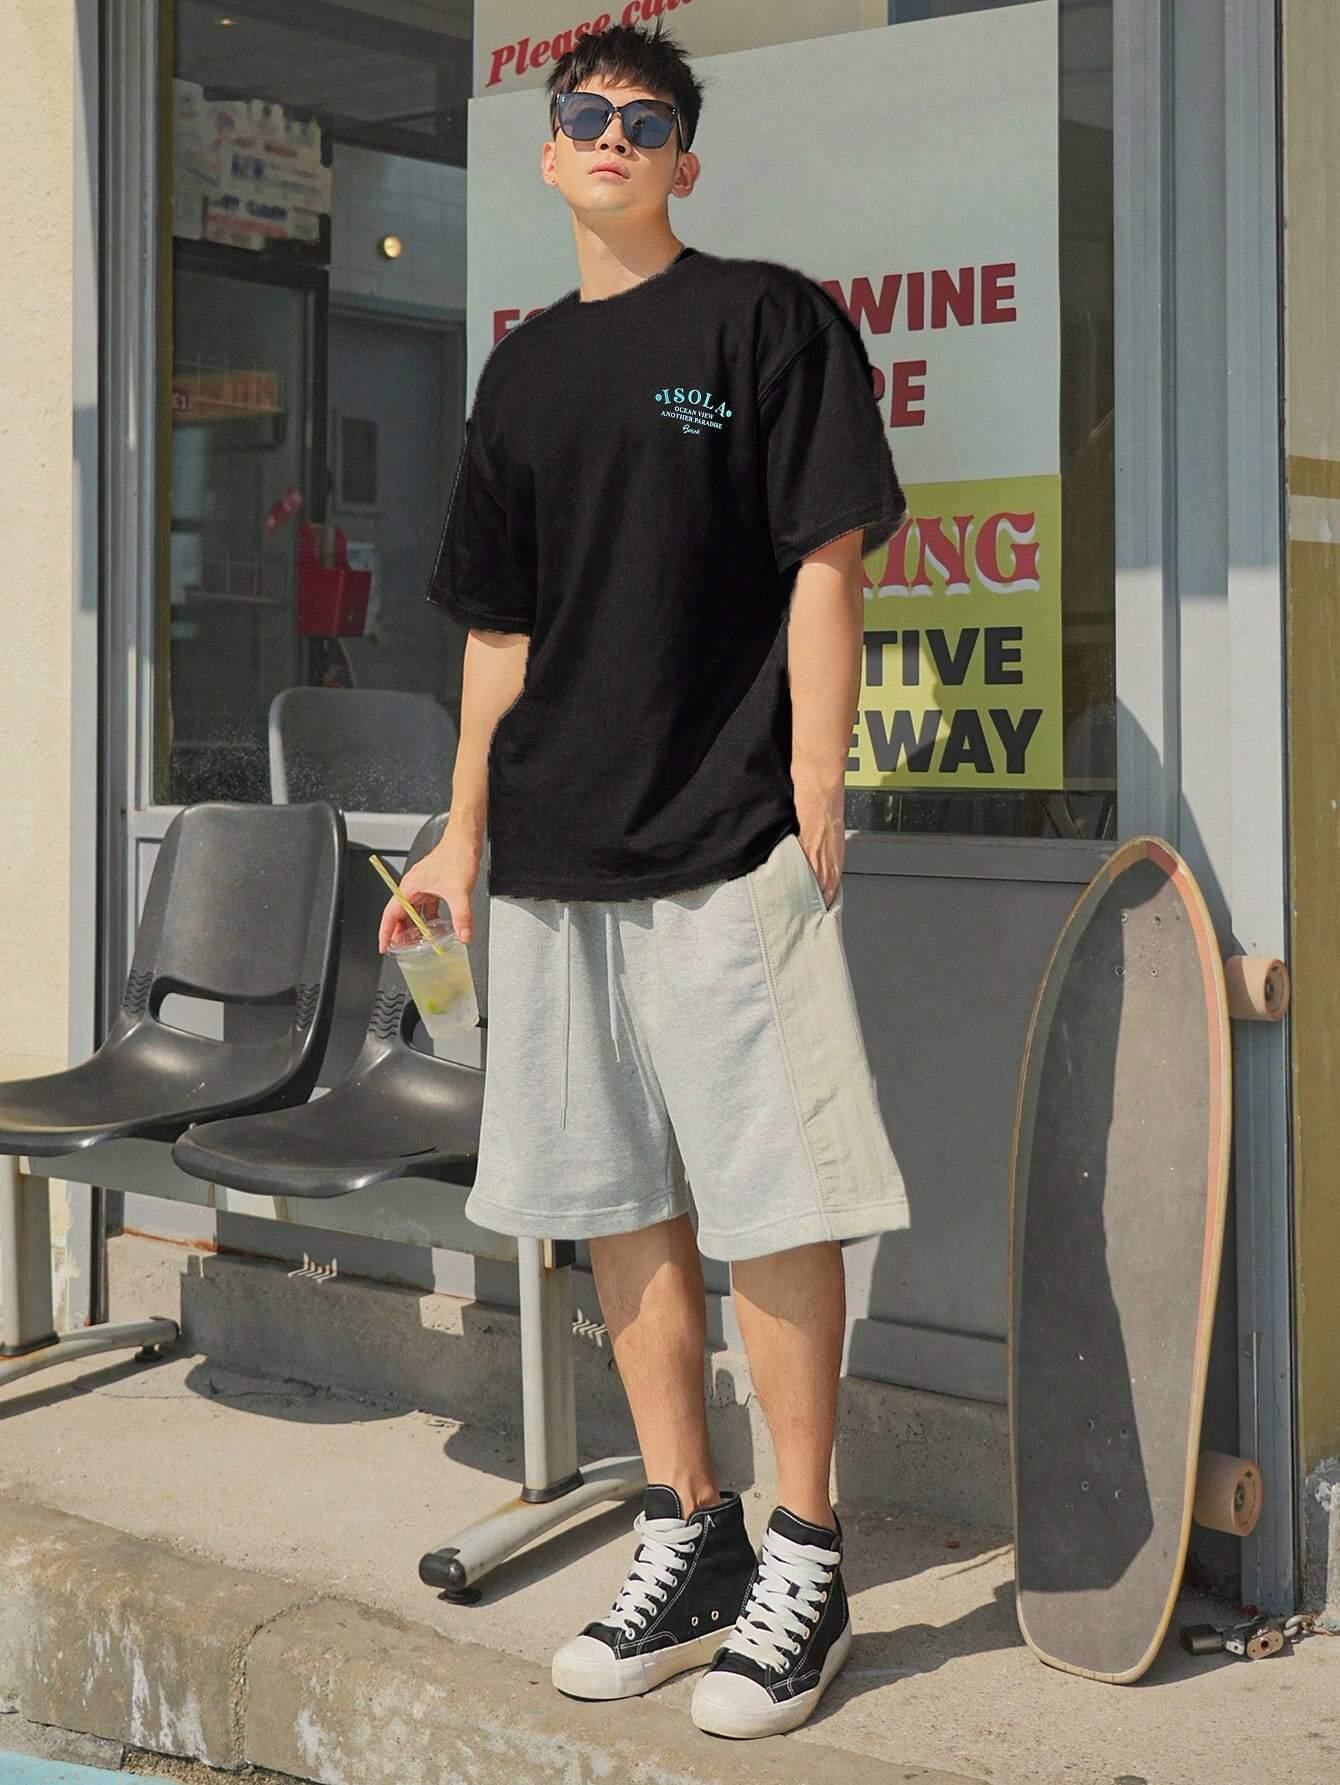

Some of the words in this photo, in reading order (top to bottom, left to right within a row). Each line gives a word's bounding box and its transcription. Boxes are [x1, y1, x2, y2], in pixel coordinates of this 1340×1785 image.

[821, 262, 1017, 335] WINE
[662, 387, 726, 418] ISOLA
[674, 405, 698, 417] OCEAN
[698, 410, 715, 420] VIEW
[660, 410, 693, 423] ANOTHER
[694, 417, 723, 430] PARADISE
[863, 511, 1041, 597] ING
